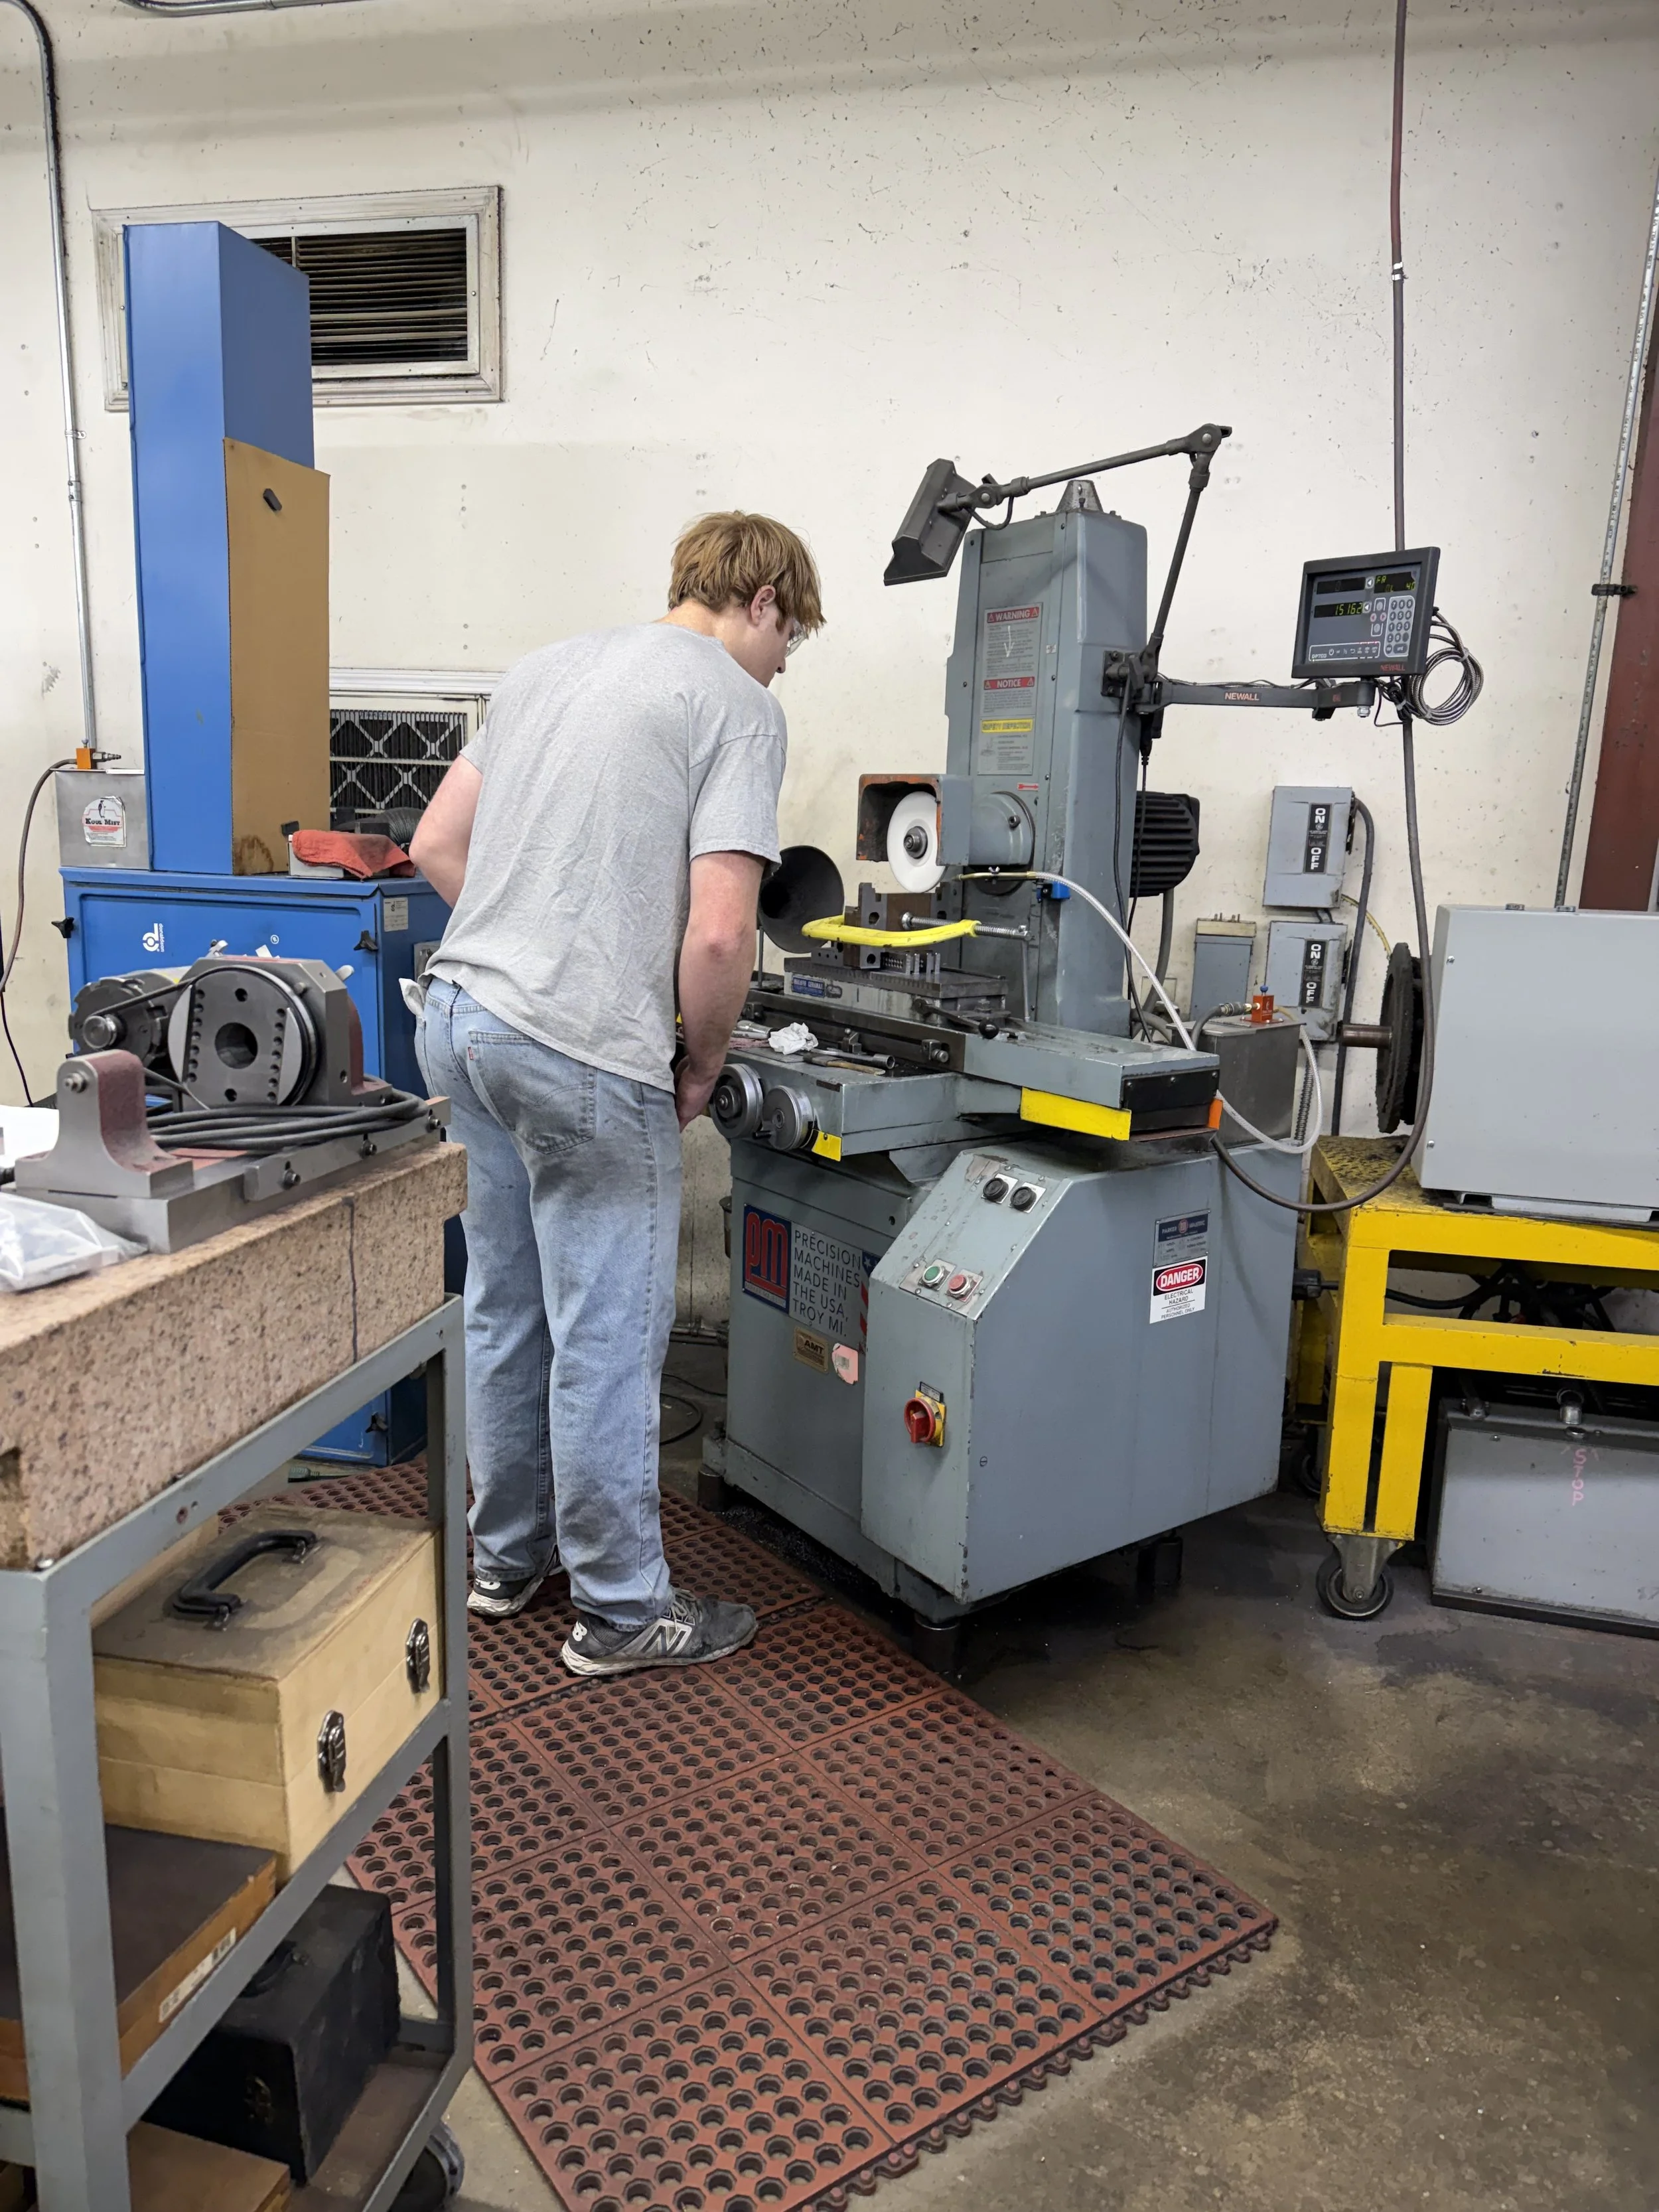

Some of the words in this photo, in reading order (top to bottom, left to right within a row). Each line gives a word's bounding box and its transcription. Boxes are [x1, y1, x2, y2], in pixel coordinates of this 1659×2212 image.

[995, 610, 1031, 622] WARNING
[996, 678, 1021, 688] NOTICE
[1224, 692, 1260, 701] NEWALL
[1315, 808, 1326, 824] ON
[1311, 847, 1322, 870] OFF
[1310, 944, 1321, 959] ON
[1305, 982, 1317, 1003] OFF
[795, 1230, 861, 1270] PRECISION
[794, 1247, 860, 1288] MACHINES
[794, 1264, 828, 1292] MADE
[833, 1282, 847, 1301] IN
[1160, 1267, 1199, 1288] DANGER
[793, 1281, 816, 1304] THE
[821, 1295, 849, 1322] USA,
[1164, 1288, 1193, 1300] ELECTRICAL
[1169, 1295, 1189, 1305] HAZARD
[1161, 1310, 1184, 1319] PERSONNEL
[1166, 1303, 1190, 1313] AUTHORIZED
[792, 1298, 824, 1325] TROY
[829, 1316, 847, 1337] MI.
[804, 1339, 824, 1355] AMT
[1571, 1448, 1587, 1507] STOP
